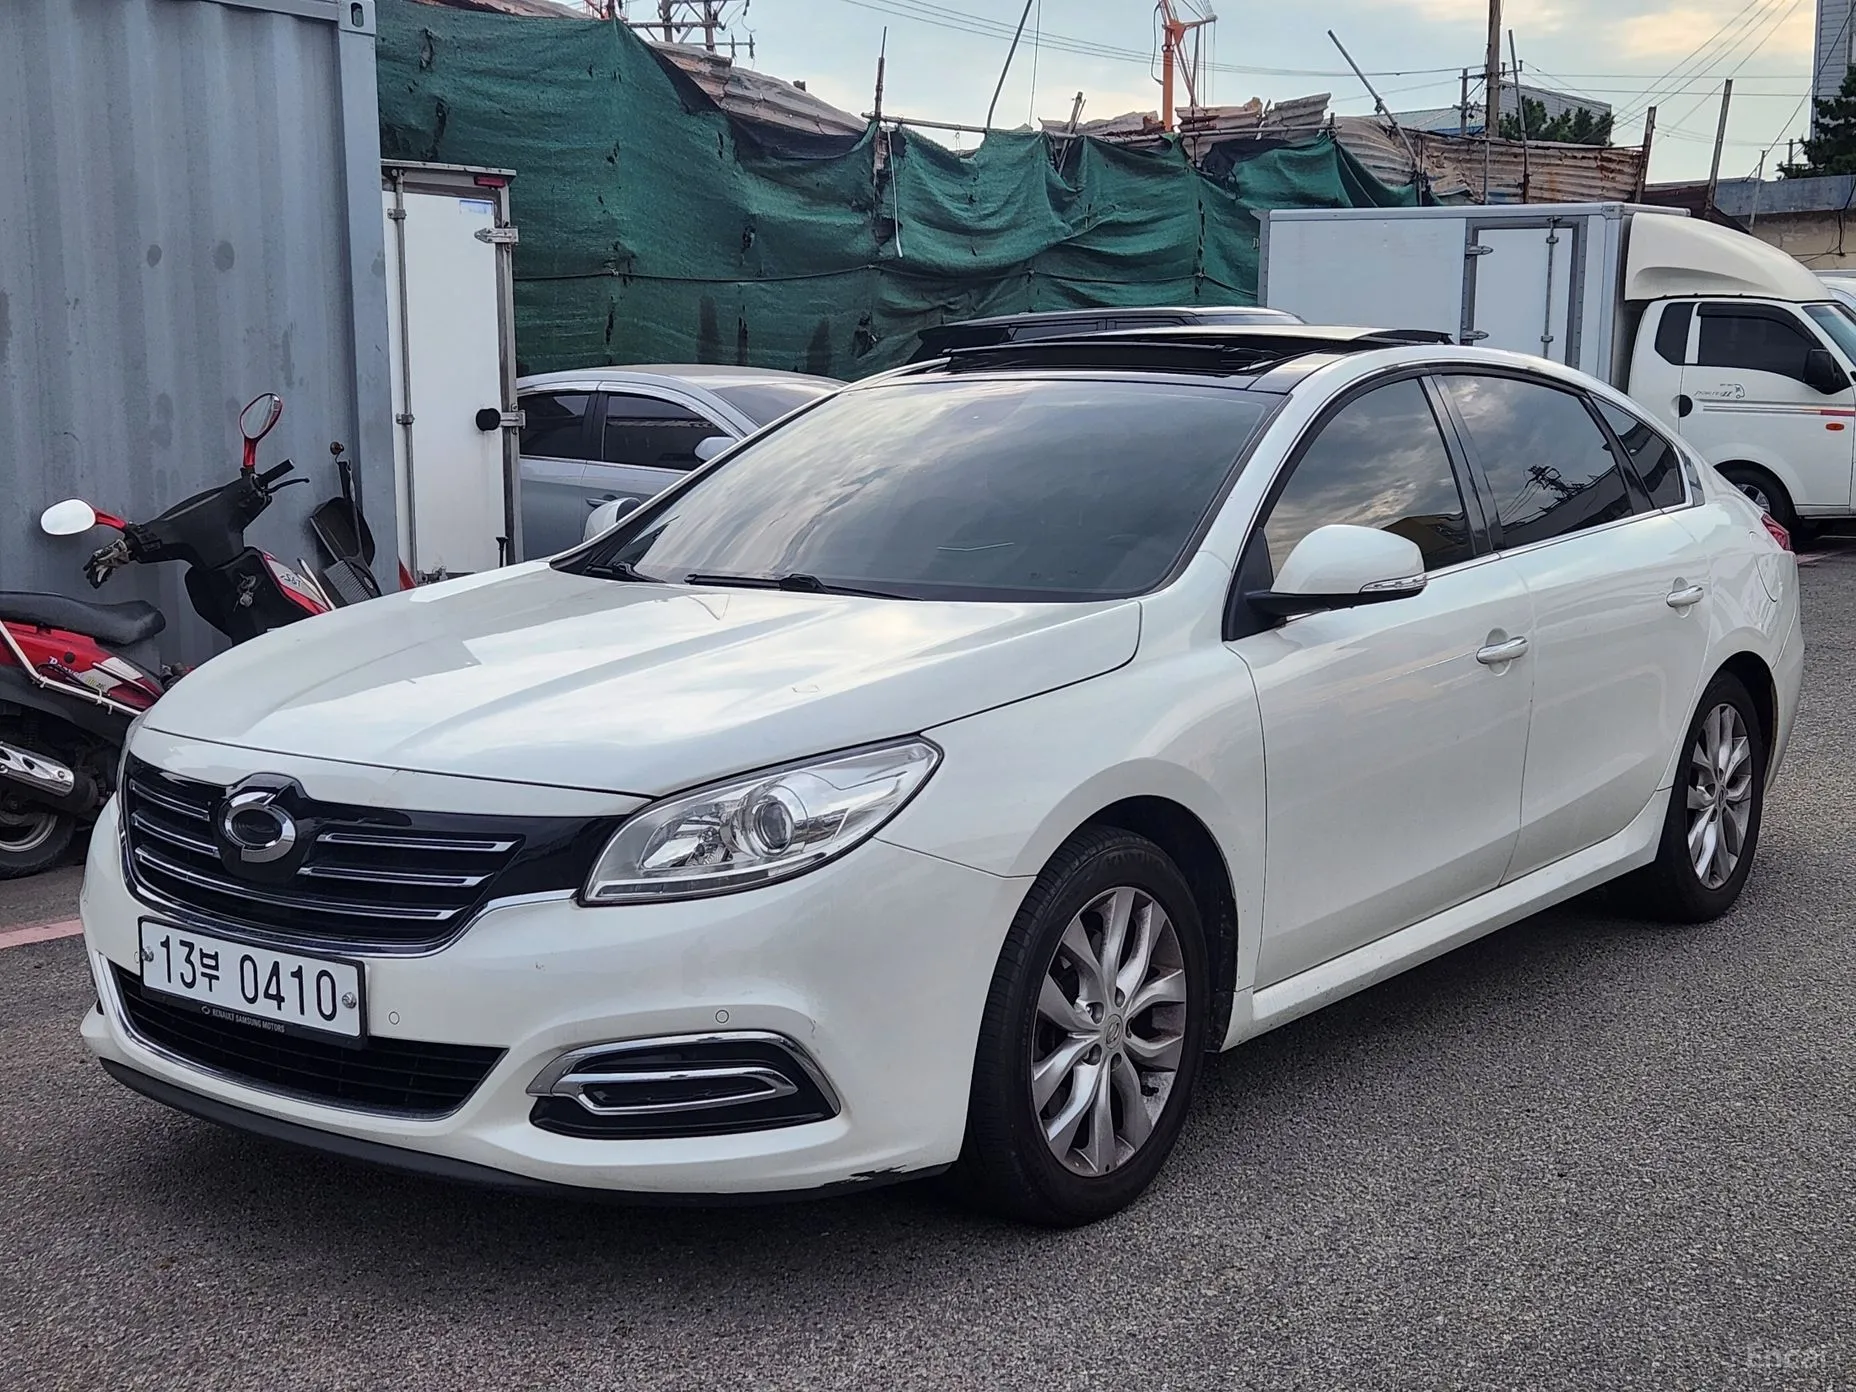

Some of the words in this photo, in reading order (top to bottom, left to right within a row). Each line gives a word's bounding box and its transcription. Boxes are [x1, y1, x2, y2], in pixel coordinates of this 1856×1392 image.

[160, 934, 220, 993] 13부
[239, 954, 337, 1022] 0410
[212, 1008, 235, 1022] RENAULT
[235, 1014, 262, 1028] SAMSUNG
[262, 1020, 285, 1033] MOTORS
